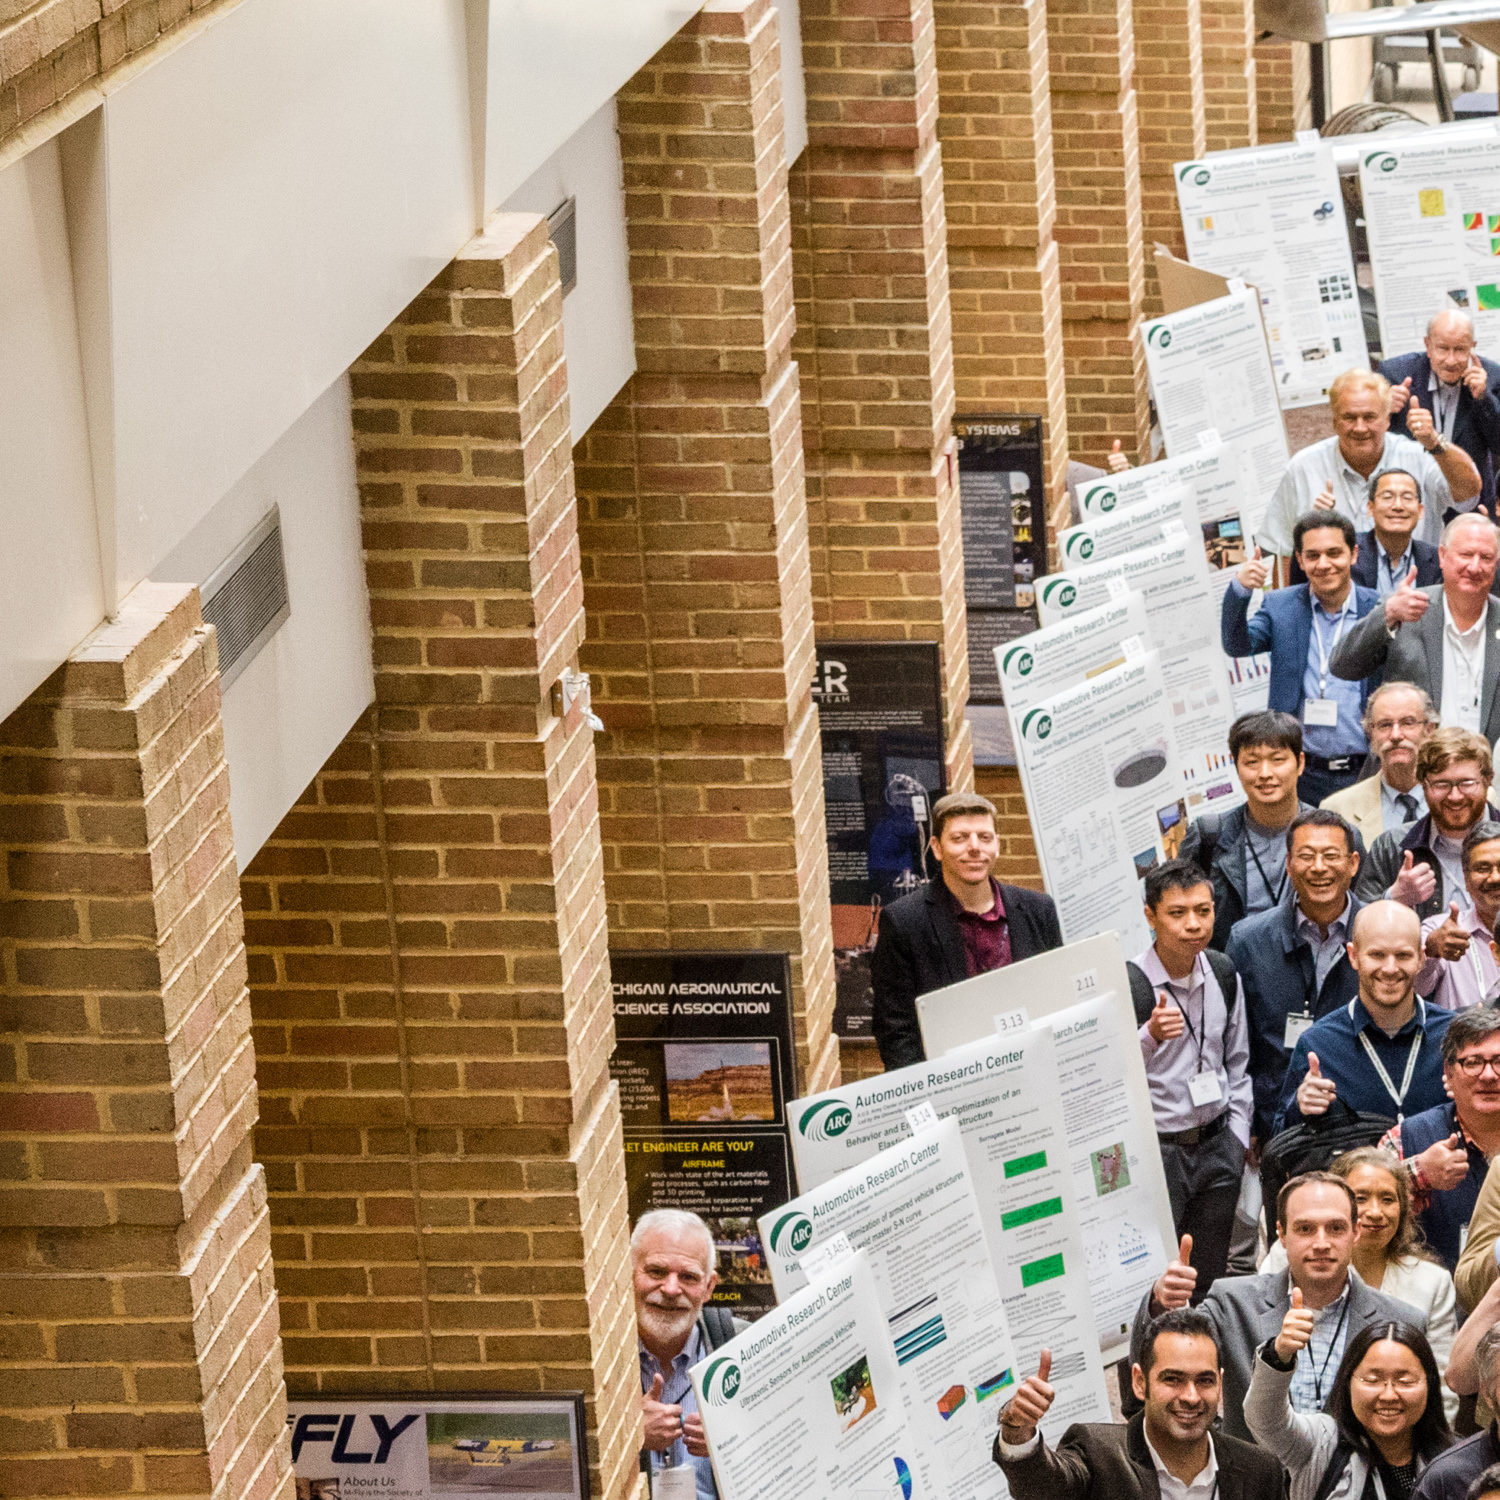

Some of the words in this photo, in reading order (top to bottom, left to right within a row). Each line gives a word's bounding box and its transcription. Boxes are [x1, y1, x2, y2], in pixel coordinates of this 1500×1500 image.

[958, 425, 1020, 436] SYSTEMS
[1052, 692, 1090, 715] Automotive
[1092, 676, 1122, 695] Research
[1124, 666, 1144, 682] Center
[669, 982, 781, 994] AERONAUTICAL
[1076, 976, 1096, 992] 2.11
[672, 1002, 770, 1014] ASSOCIATION
[1000, 1014, 1024, 1031] 3.13
[855, 1080, 923, 1108] Automotive
[927, 1061, 982, 1087] Research
[985, 1050, 1024, 1069] Center
[825, 1114, 851, 1131] ARC
[911, 1108, 931, 1126] 3.14
[642, 1142, 698, 1152] ENGINEER
[701, 1141, 724, 1152] ARE
[726, 1140, 754, 1151] YOU?
[682, 1159, 725, 1168] AIRFRAME
[812, 1184, 865, 1219] Automotive
[866, 1159, 909, 1189] Research
[910, 1142, 939, 1165] Center
[791, 1225, 812, 1246] ARC
[825, 1236, 850, 1260] 3.A61
[740, 1323, 787, 1363] Automotive
[787, 1295, 825, 1329] Research
[826, 1275, 852, 1301] Center
[739, 1383, 768, 1408] Ultrasonic
[768, 1367, 792, 1387] Sensors
[791, 1360, 800, 1370] for
[801, 1335, 834, 1364] Autonomous
[833, 1319, 856, 1339] Vehicles
[722, 1370, 741, 1393] ARC
[344, 1476, 375, 1487] About
[381, 1476, 395, 1487] Us
